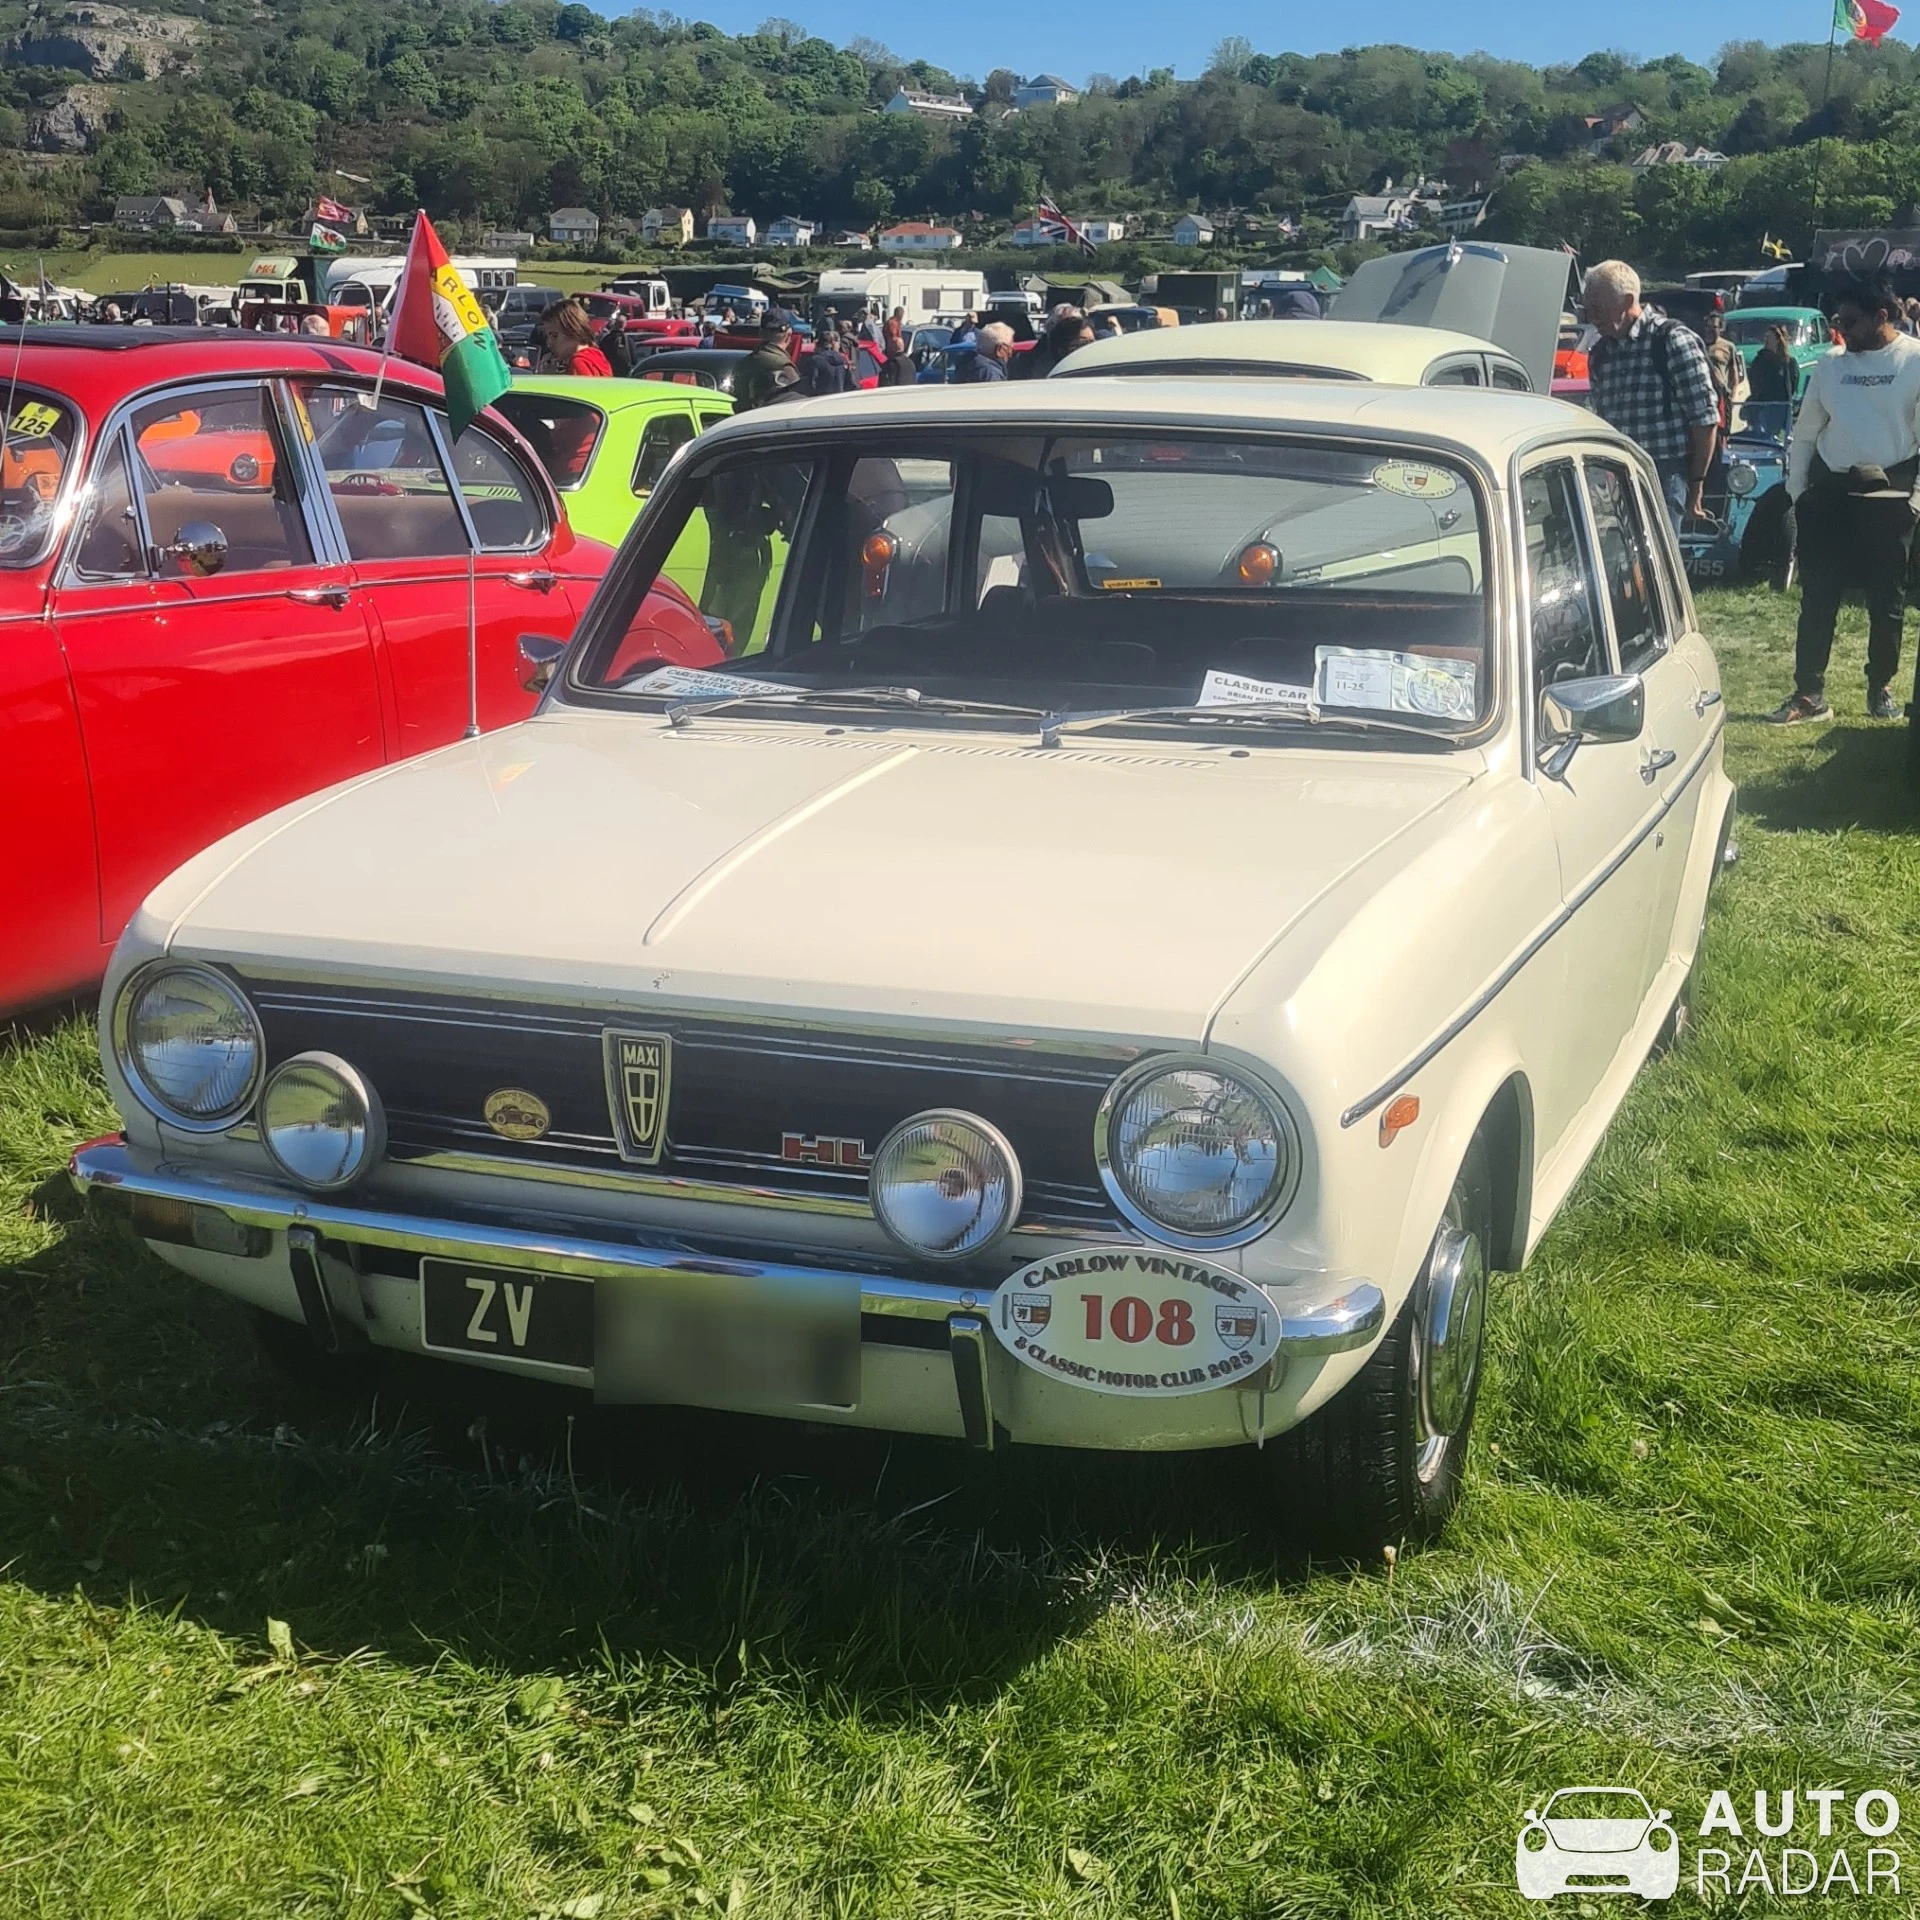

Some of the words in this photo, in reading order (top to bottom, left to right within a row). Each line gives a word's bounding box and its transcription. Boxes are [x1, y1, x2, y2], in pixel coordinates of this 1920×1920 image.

[14, 415, 49, 435] 125
[1214, 676, 1273, 696] CLASSIC
[1278, 689, 1308, 701] CAR
[1336, 681, 1365, 692] 11-25
[623, 1043, 660, 1068] MAXI
[781, 1131, 875, 1168] HL
[1023, 1253, 1131, 1289] CARLOW
[1132, 1254, 1248, 1303] VINTAGE
[465, 1277, 534, 1347] ZV
[1080, 1293, 1196, 1347] 108
[1013, 1335, 1028, 1350] &
[1027, 1344, 1098, 1382] CLASSIC
[1098, 1369, 1160, 1389] MOTOR
[1160, 1367, 1207, 1389] CLUB
[1207, 1349, 1255, 1379] 2025
